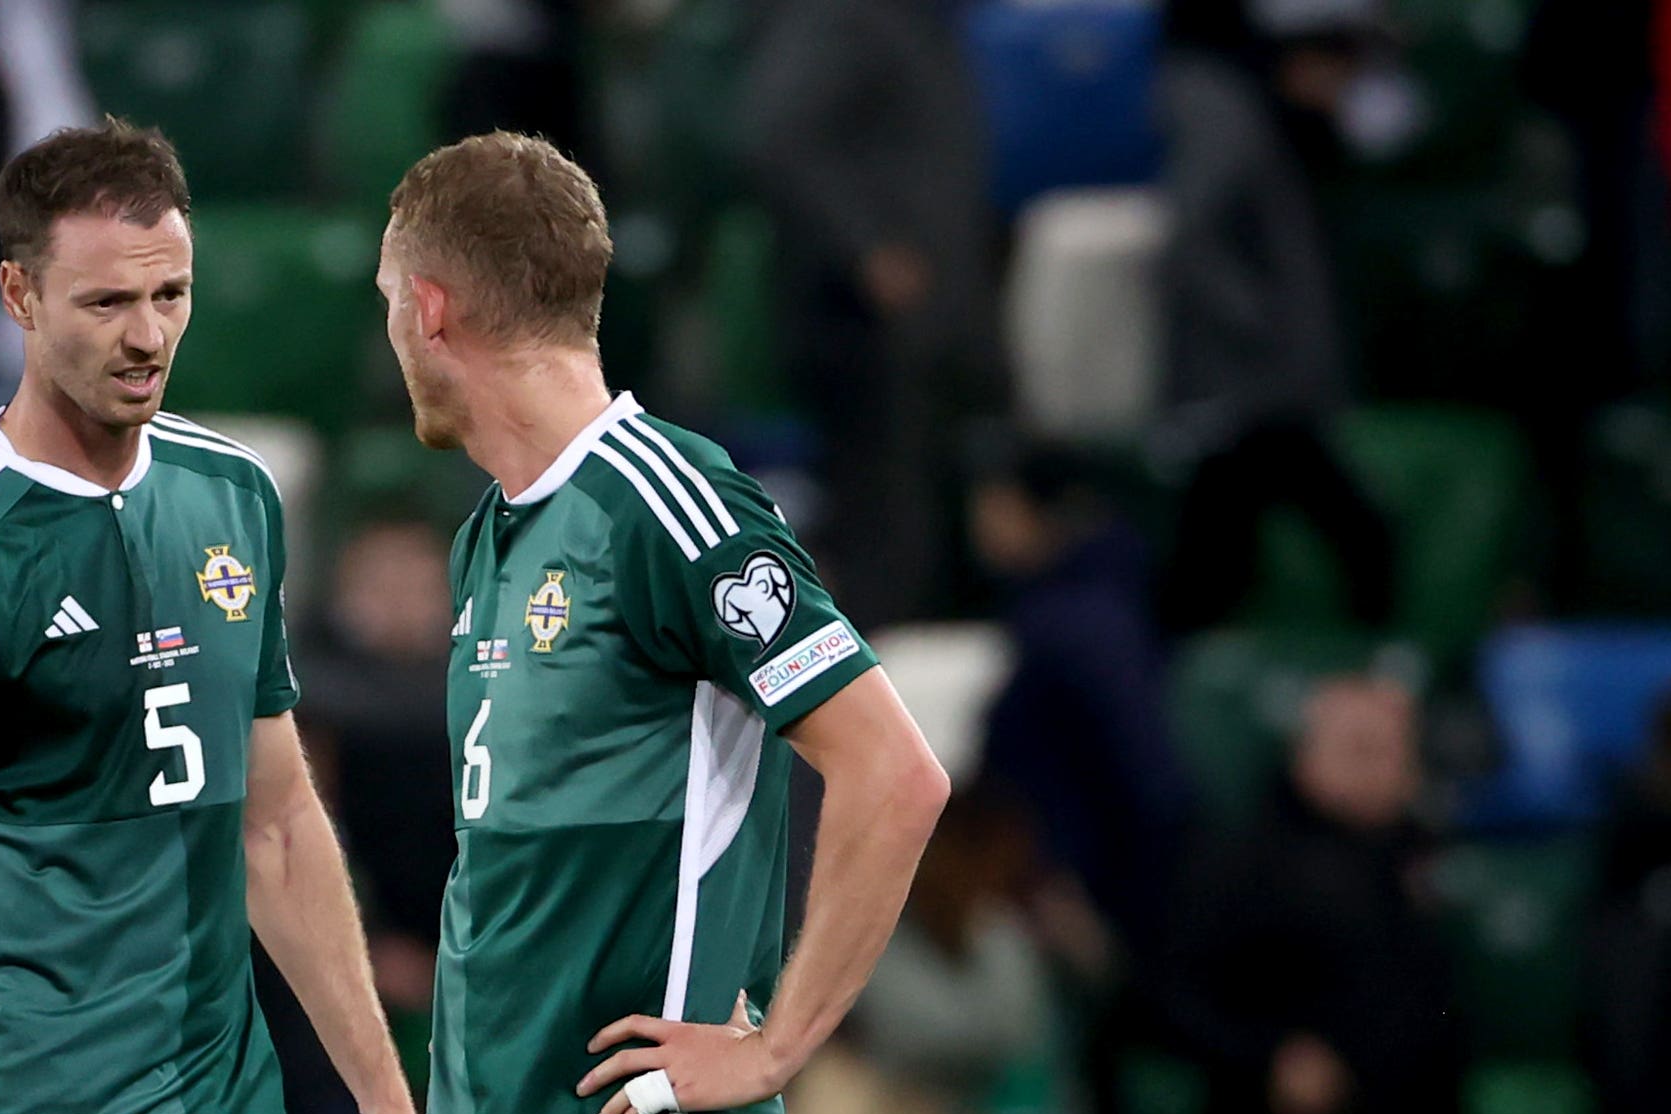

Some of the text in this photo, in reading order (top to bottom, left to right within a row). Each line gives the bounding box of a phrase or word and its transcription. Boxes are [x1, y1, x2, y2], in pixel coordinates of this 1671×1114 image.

[758, 631, 850, 694] FOUNDATION
[144, 682, 205, 806] 5
[461, 699, 492, 820] 6
